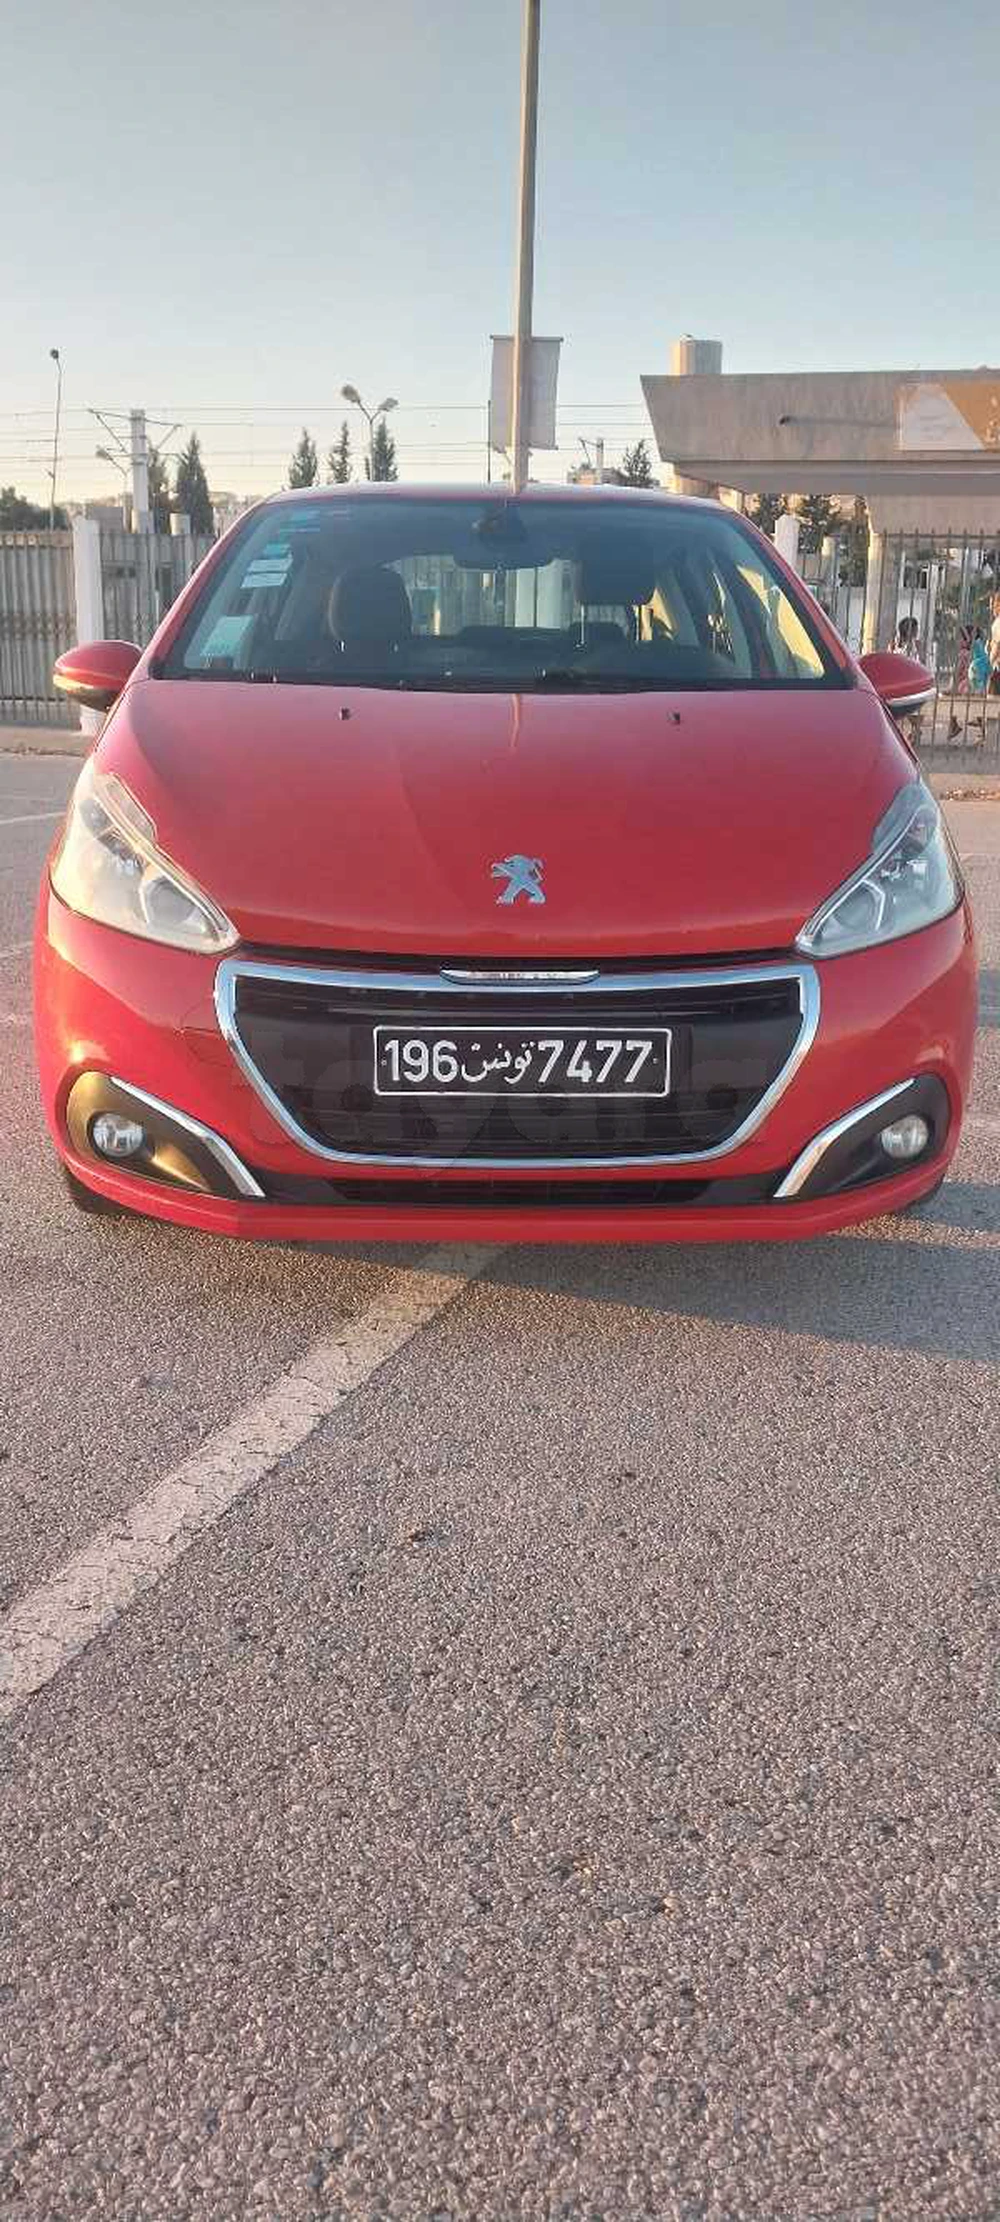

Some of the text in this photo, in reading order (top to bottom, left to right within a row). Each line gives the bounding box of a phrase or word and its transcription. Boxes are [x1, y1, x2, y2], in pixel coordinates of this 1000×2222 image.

[384, 1040, 653, 1084] 196 تونس 7477
